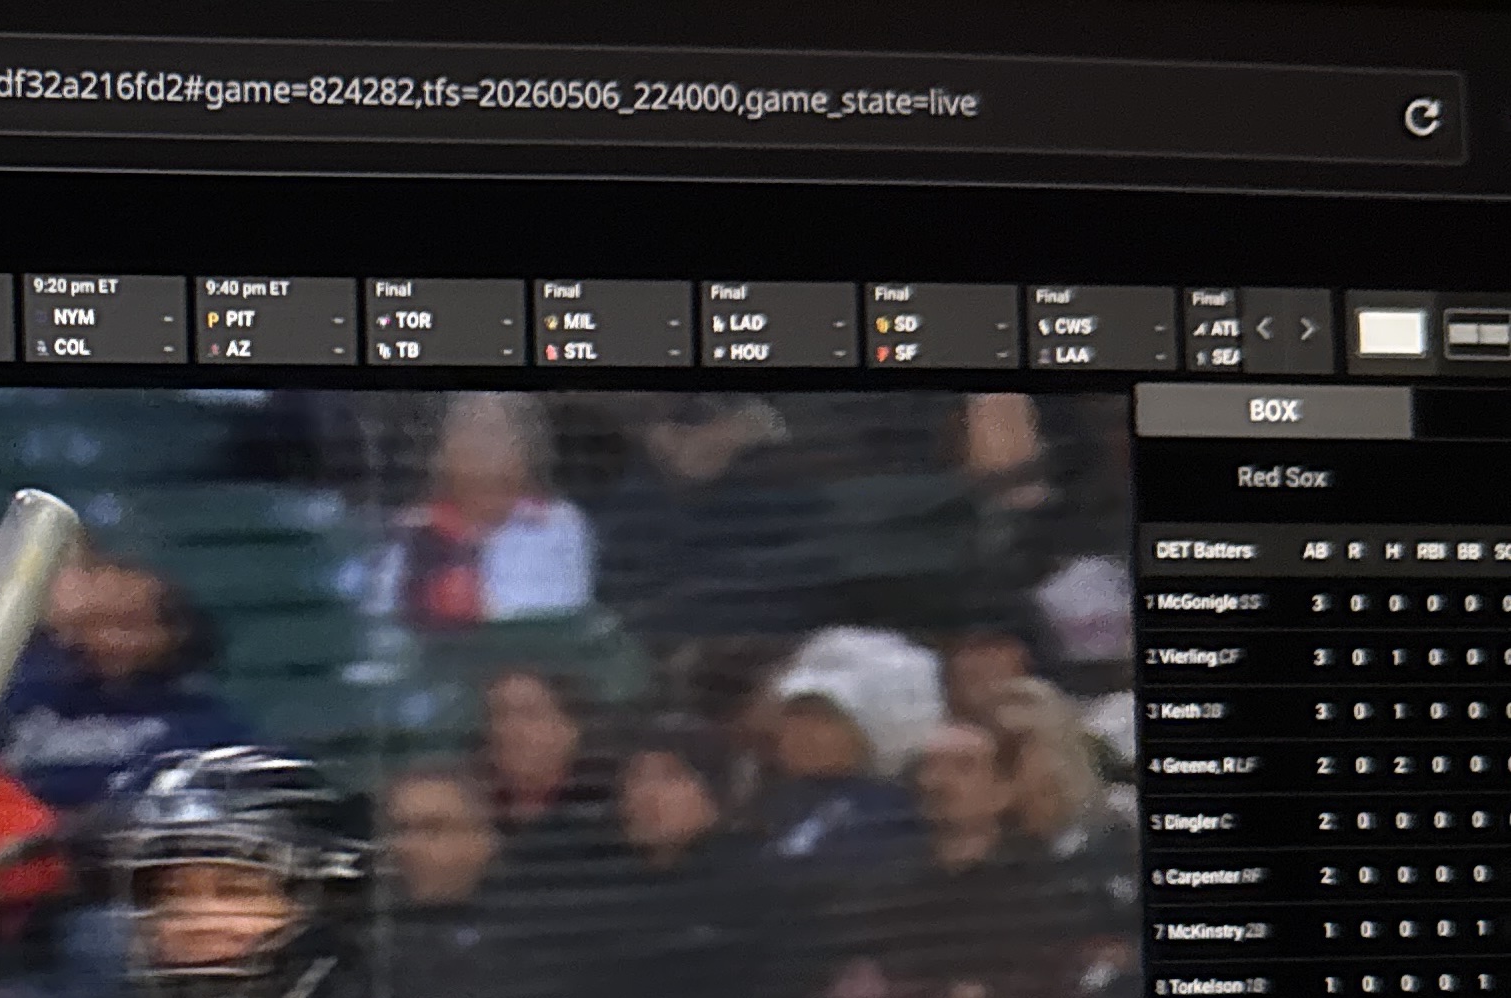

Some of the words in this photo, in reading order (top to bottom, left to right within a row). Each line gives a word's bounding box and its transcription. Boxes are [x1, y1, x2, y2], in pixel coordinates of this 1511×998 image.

[34, 278, 67, 293] 9:20
[71, 282, 94, 296] pm
[99, 279, 118, 293] ET
[206, 280, 239, 295] 9:40
[243, 283, 266, 298] pm
[270, 281, 289, 295] ET
[376, 282, 411, 296] Final
[544, 283, 580, 298] Final
[711, 285, 747, 299] Final
[875, 286, 910, 301] Final
[54, 309, 94, 325] NYM
[226, 311, 255, 326] PIT
[396, 312, 431, 328] TOR
[564, 313, 595, 329] MIL
[730, 315, 766, 330] LAD
[895, 315, 918, 331] SD
[1055, 318, 1093, 334] CWS
[54, 338, 90, 355] COL
[226, 340, 250, 356] AZ
[396, 342, 419, 358] TB
[565, 342, 597, 359] STL
[731, 344, 769, 360] HOU
[895, 344, 917, 361] SF
[1056, 347, 1090, 363] LAA
[1250, 399, 1298, 421] BOX
[1238, 466, 1281, 487] Red
[1286, 467, 1327, 487] Sox
[1157, 541, 1192, 558] DET
[1191, 542, 1254, 558] Batters
[1303, 542, 1329, 559] AB
[1162, 703, 1204, 719] Keith
[1166, 869, 1243, 887] Carpenter
[1168, 924, 1246, 941] McKinstry
[1169, 979, 1245, 994] Torkelson
